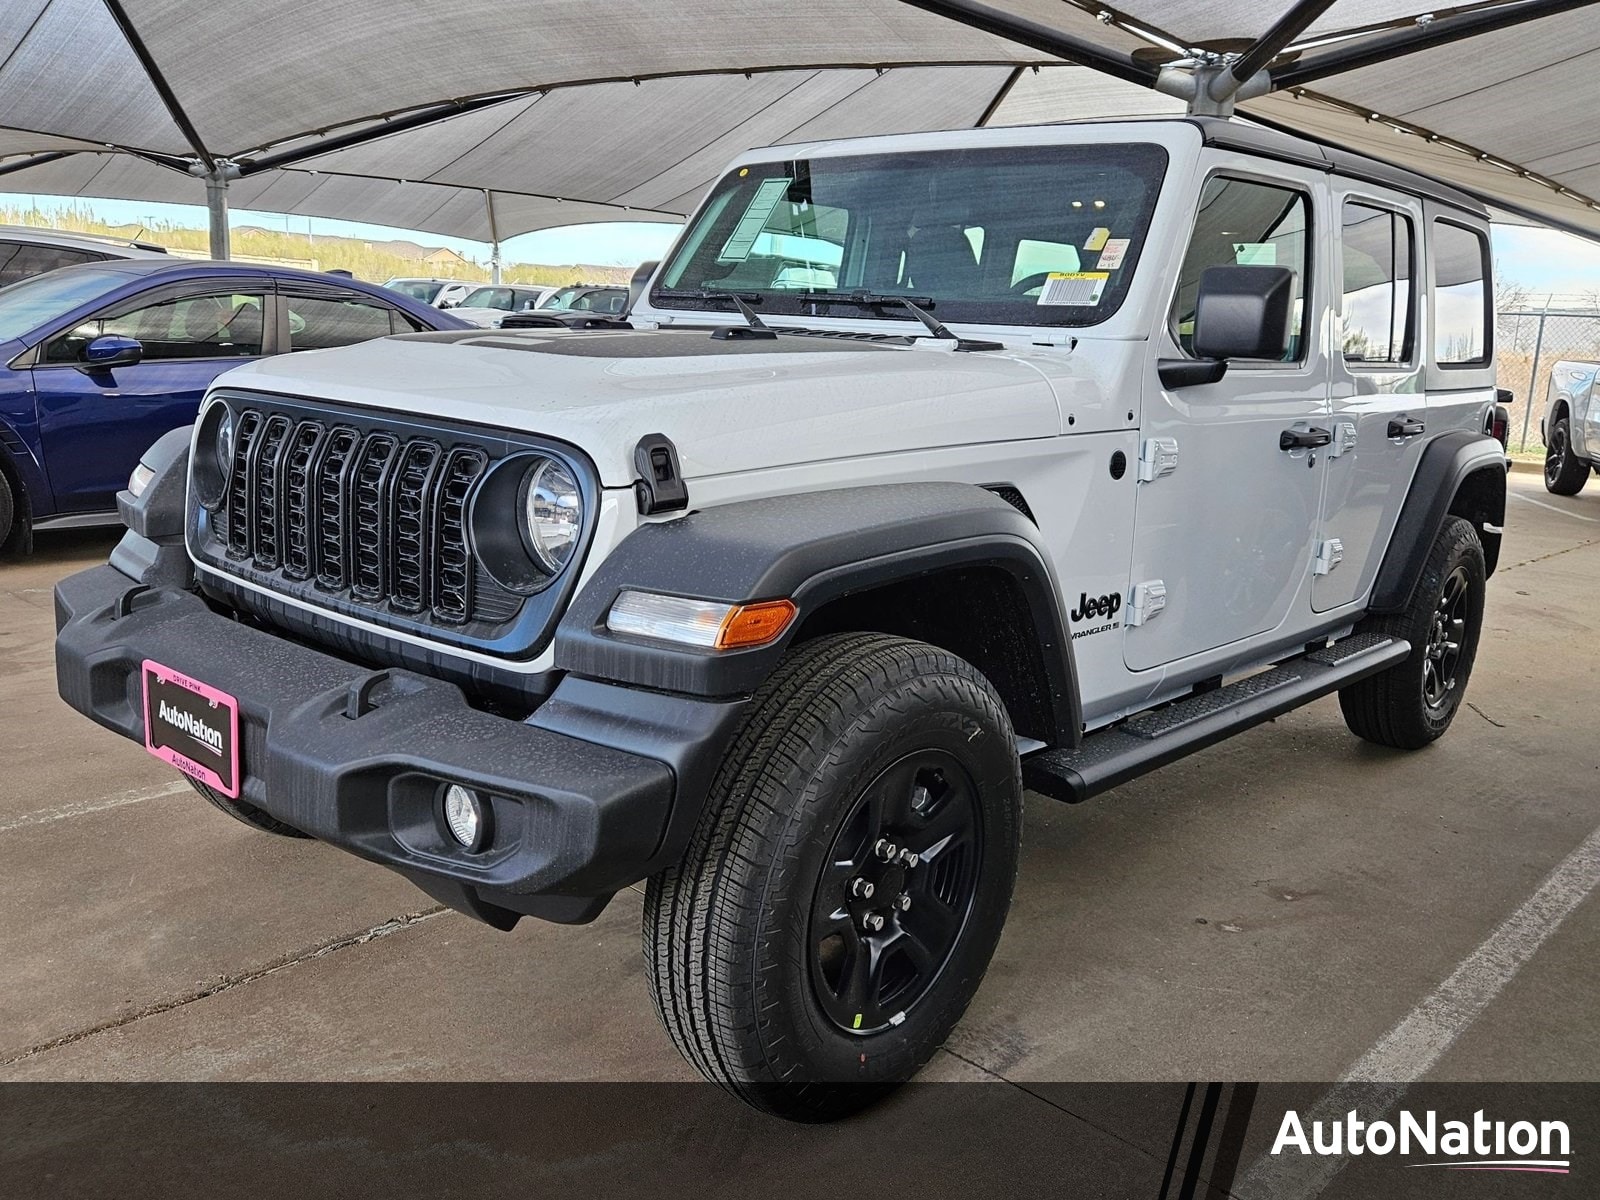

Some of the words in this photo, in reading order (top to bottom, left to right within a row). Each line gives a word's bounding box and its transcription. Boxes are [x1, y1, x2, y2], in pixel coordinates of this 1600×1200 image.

[1071, 592, 1121, 622] Jeep
[173, 674, 188, 688] DRIVE
[189, 681, 201, 692] PINK
[159, 700, 223, 749] AutoNation
[171, 754, 206, 781] AutoNation
